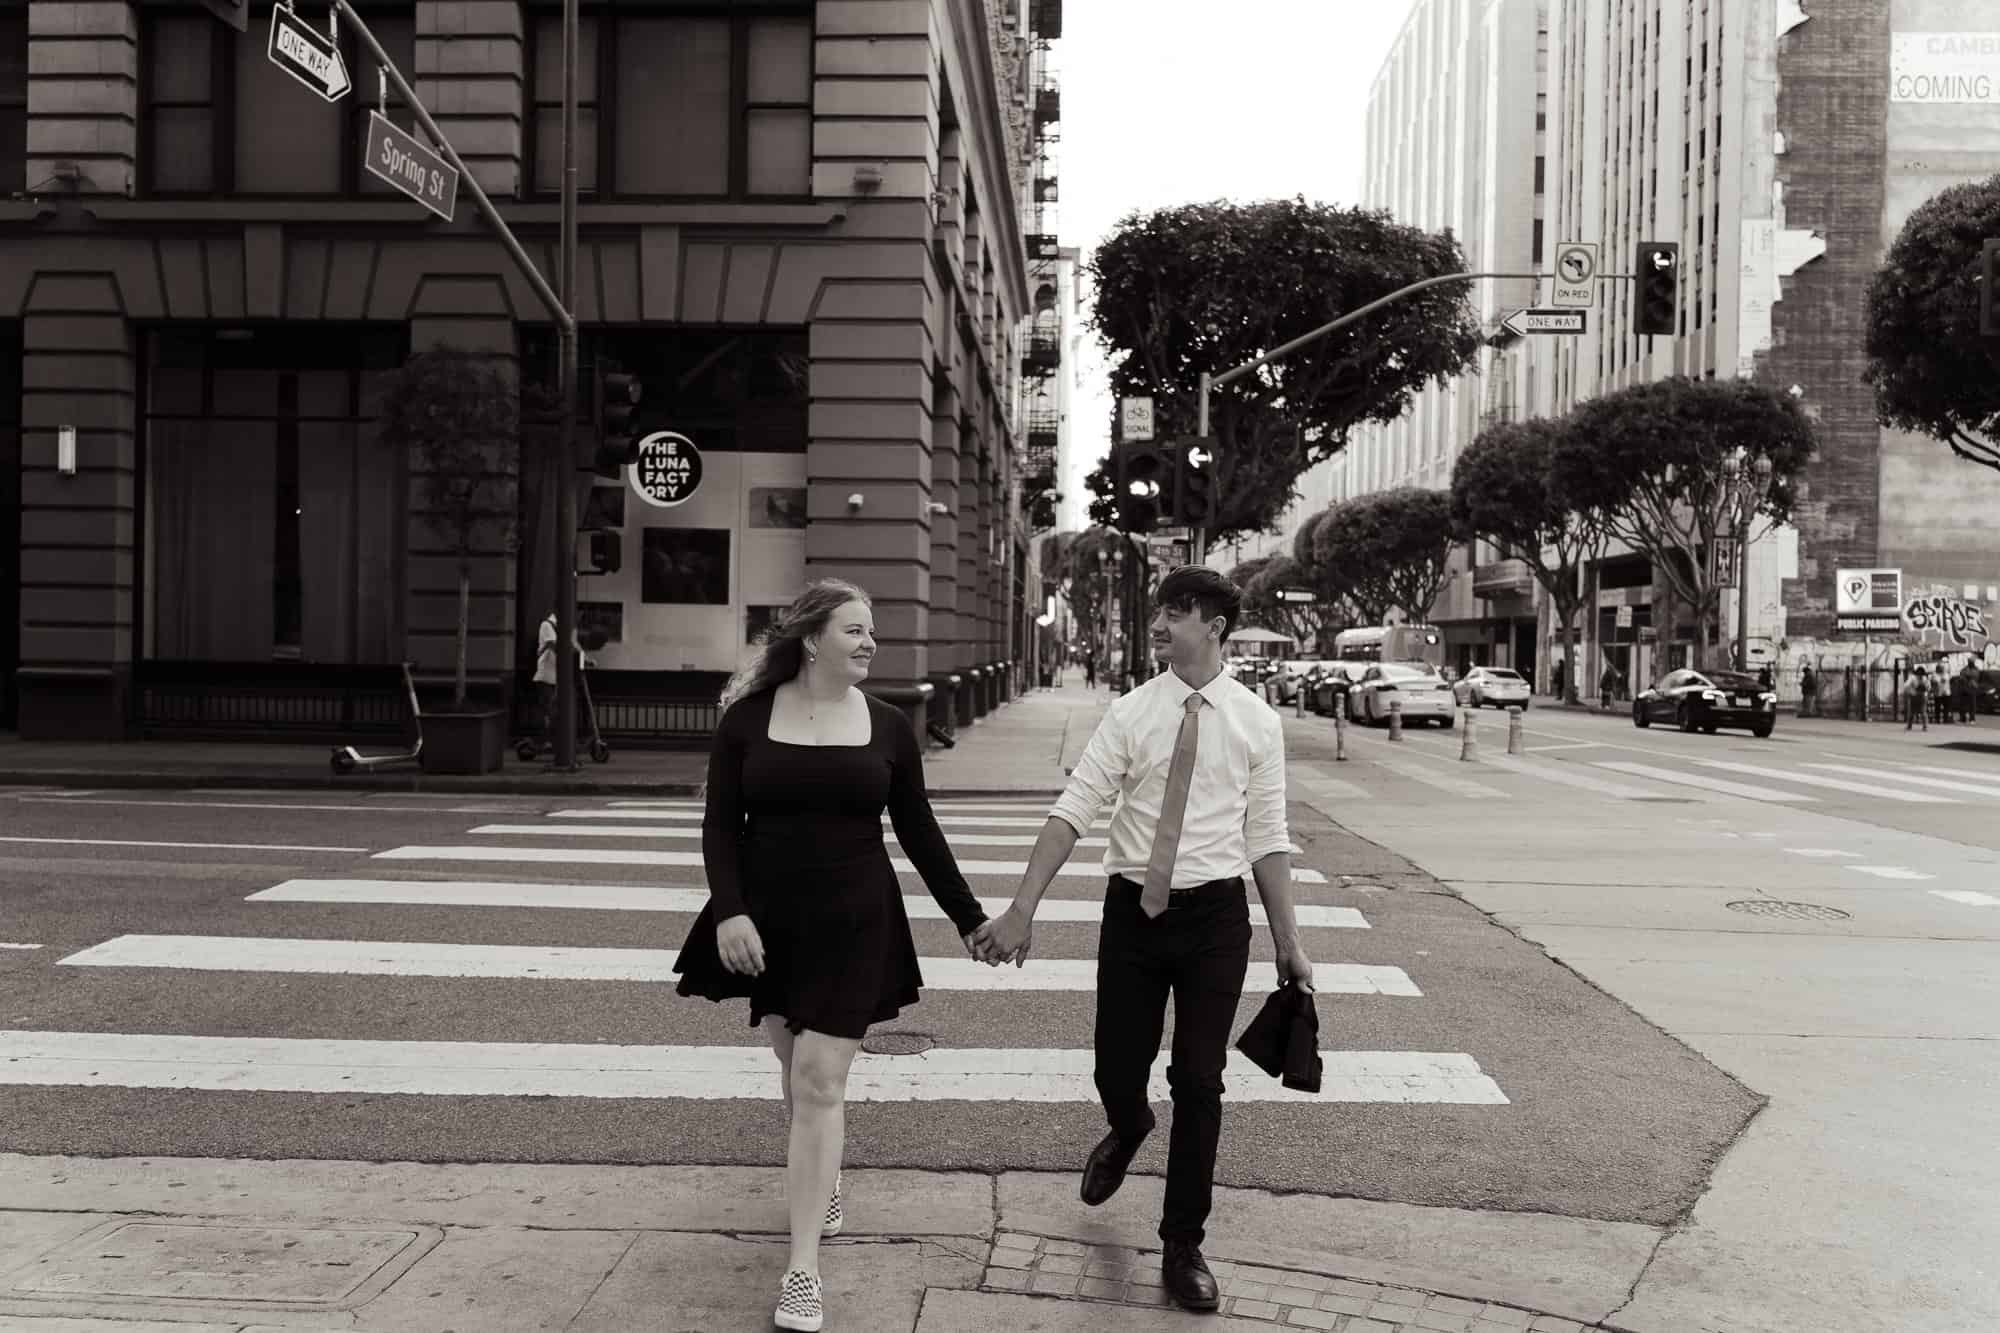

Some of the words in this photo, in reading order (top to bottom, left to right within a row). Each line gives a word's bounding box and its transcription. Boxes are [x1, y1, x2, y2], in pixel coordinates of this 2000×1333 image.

[1927, 37, 2000, 55] CAMB
[283, 30, 304, 61] ONE
[309, 51, 330, 78] WAY
[1897, 75, 1991, 99] COMING
[381, 137, 425, 195] Spring
[430, 169, 445, 200] St
[1558, 289, 1570, 297] ON
[1572, 290, 1589, 298] RED
[1528, 318, 1551, 327] ONE
[1555, 318, 1577, 326] WAY
[646, 442, 677, 455] THE
[645, 457, 690, 470] LUNA
[645, 471, 690, 484] FACT
[644, 485, 679, 499] ORY
[1851, 582, 1862, 594] P
